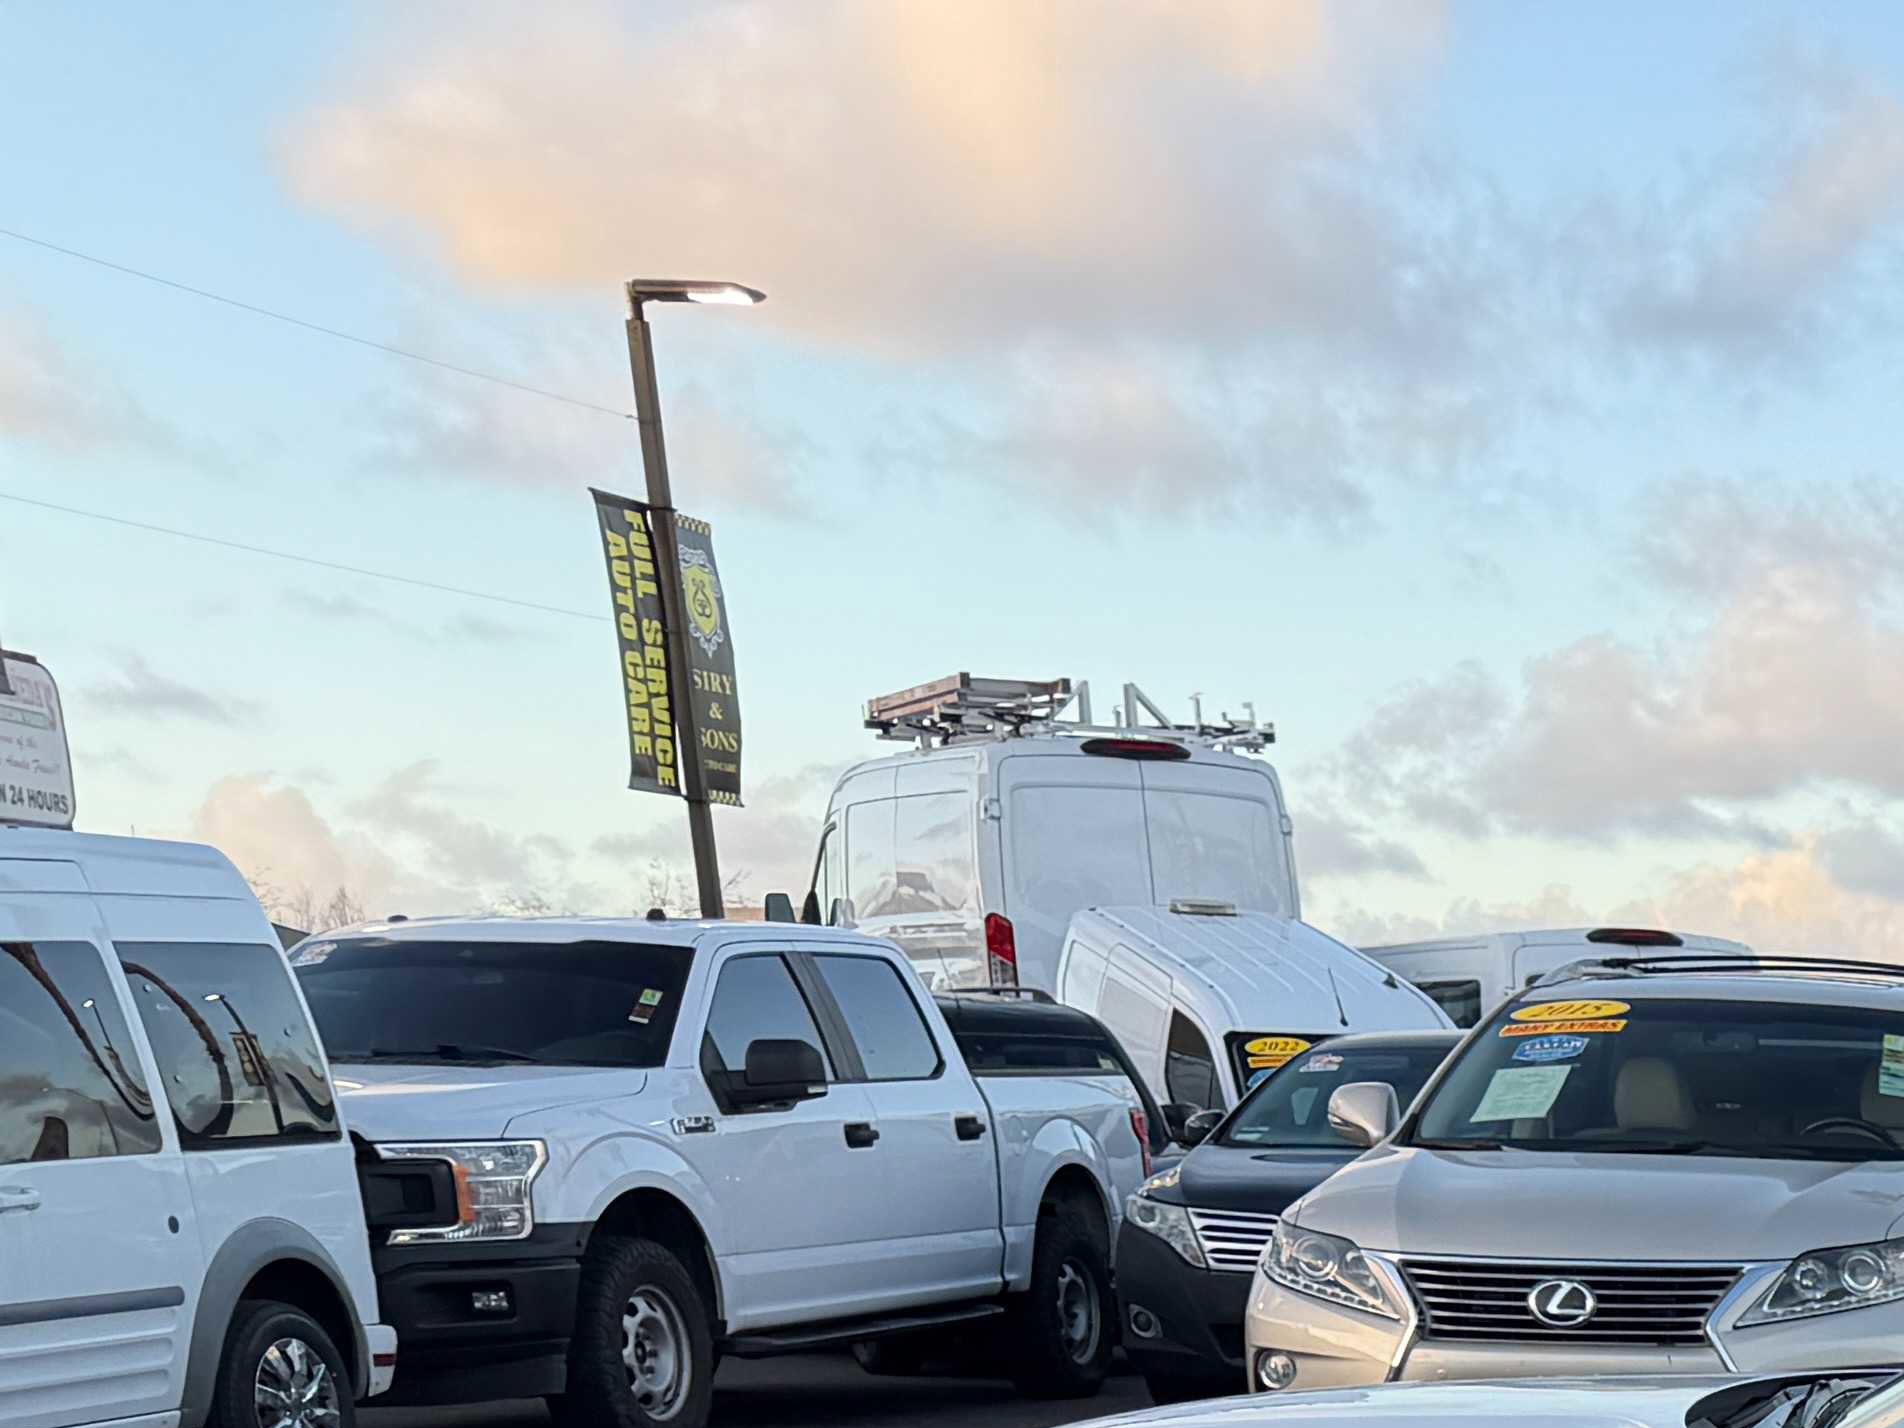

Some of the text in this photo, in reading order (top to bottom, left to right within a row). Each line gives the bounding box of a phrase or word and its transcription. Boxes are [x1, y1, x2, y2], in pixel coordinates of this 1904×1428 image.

[605, 527, 652, 756] AUTO CARE
[624, 509, 675, 788] FULL SERVICE
[692, 668, 733, 696] SIRY
[708, 701, 724, 721] &
[8, 784, 24, 806] 24
[26, 788, 69, 815] HOURS
[1257, 1039, 1301, 1052] 2022
